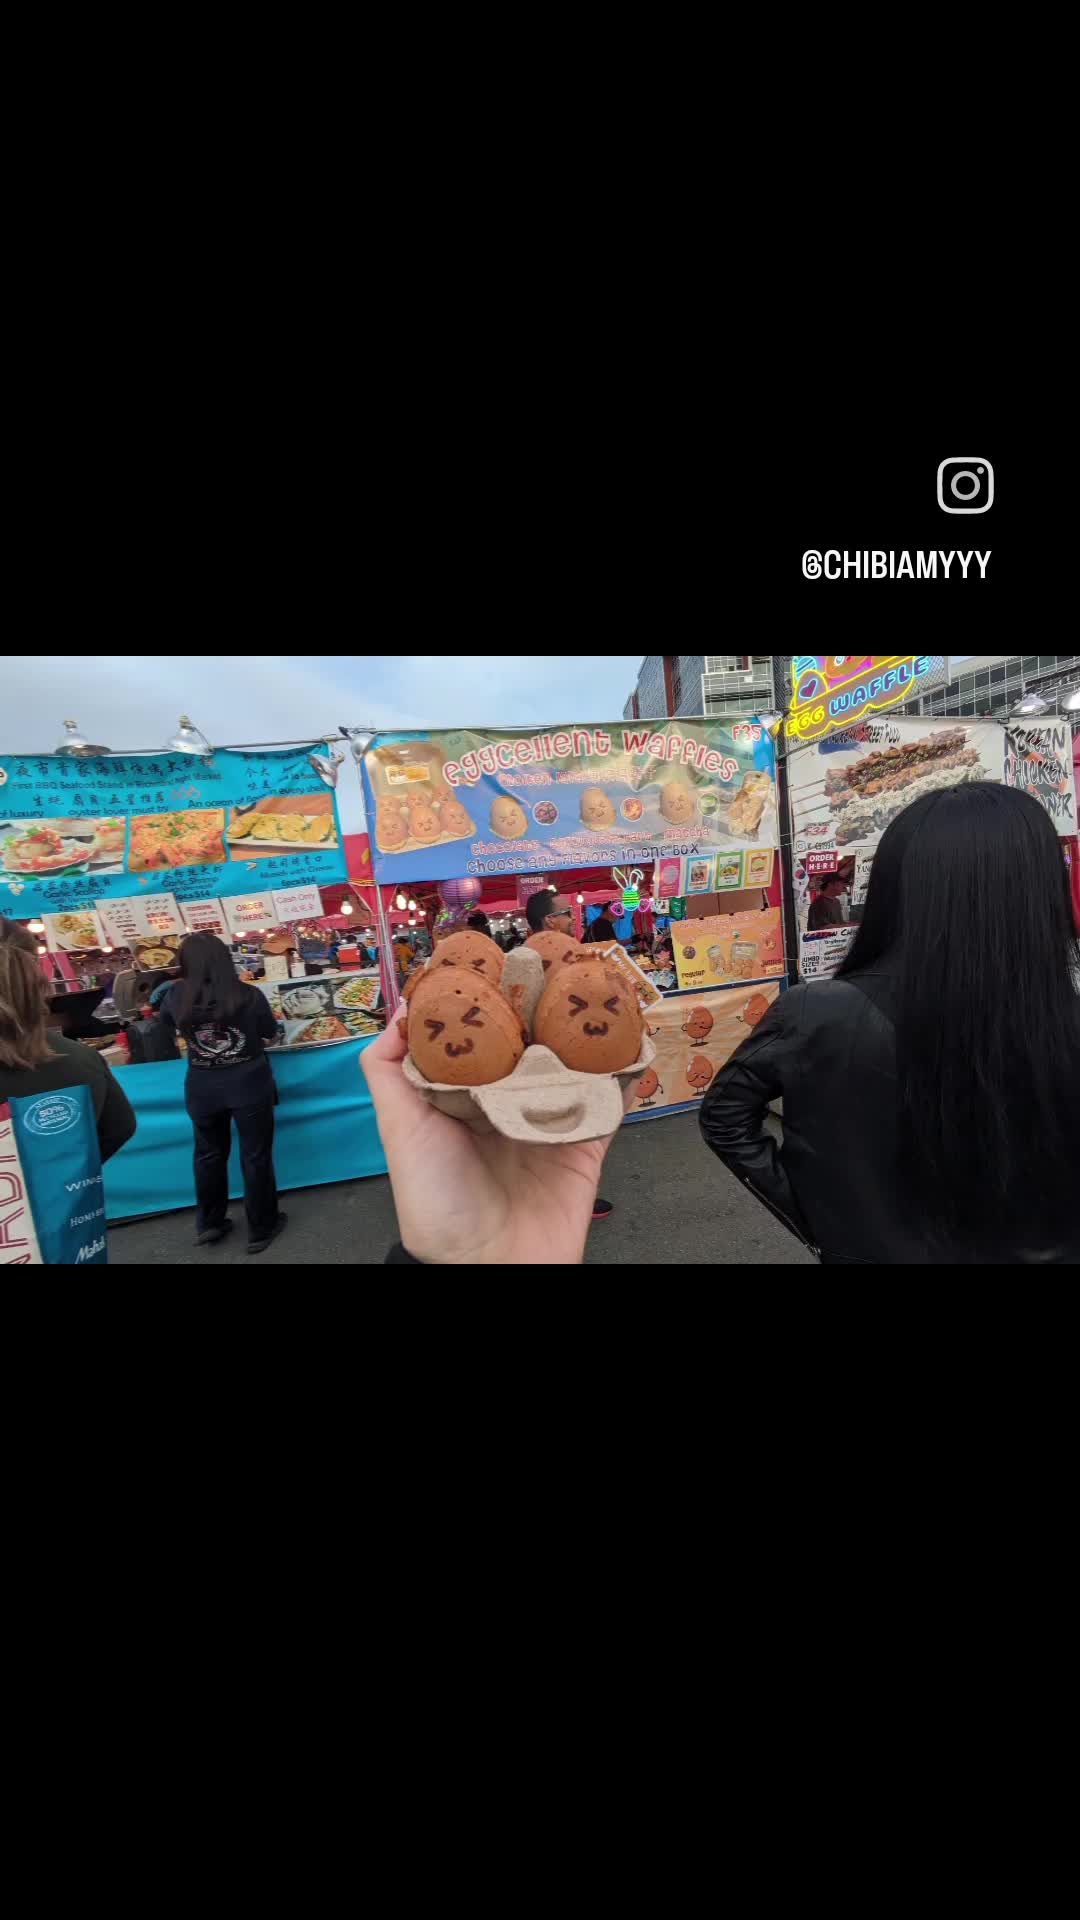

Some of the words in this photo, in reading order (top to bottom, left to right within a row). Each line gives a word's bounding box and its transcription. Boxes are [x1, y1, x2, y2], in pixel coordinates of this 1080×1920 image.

[786, 705, 826, 737] EGG
[828, 656, 930, 717] WAFFLE
[731, 723, 763, 741] F35
[1003, 725, 1066, 758] KOREAN
[441, 729, 610, 787] eggcellent
[622, 728, 740, 783] waffles
[1003, 757, 1069, 789] CHICKEN
[187, 799, 203, 809] An
[204, 798, 234, 808] ocean
[68, 808, 102, 818] oyster
[809, 853, 835, 862] ORDER
[235, 902, 264, 912] ORDER
[242, 912, 264, 922] HERE
